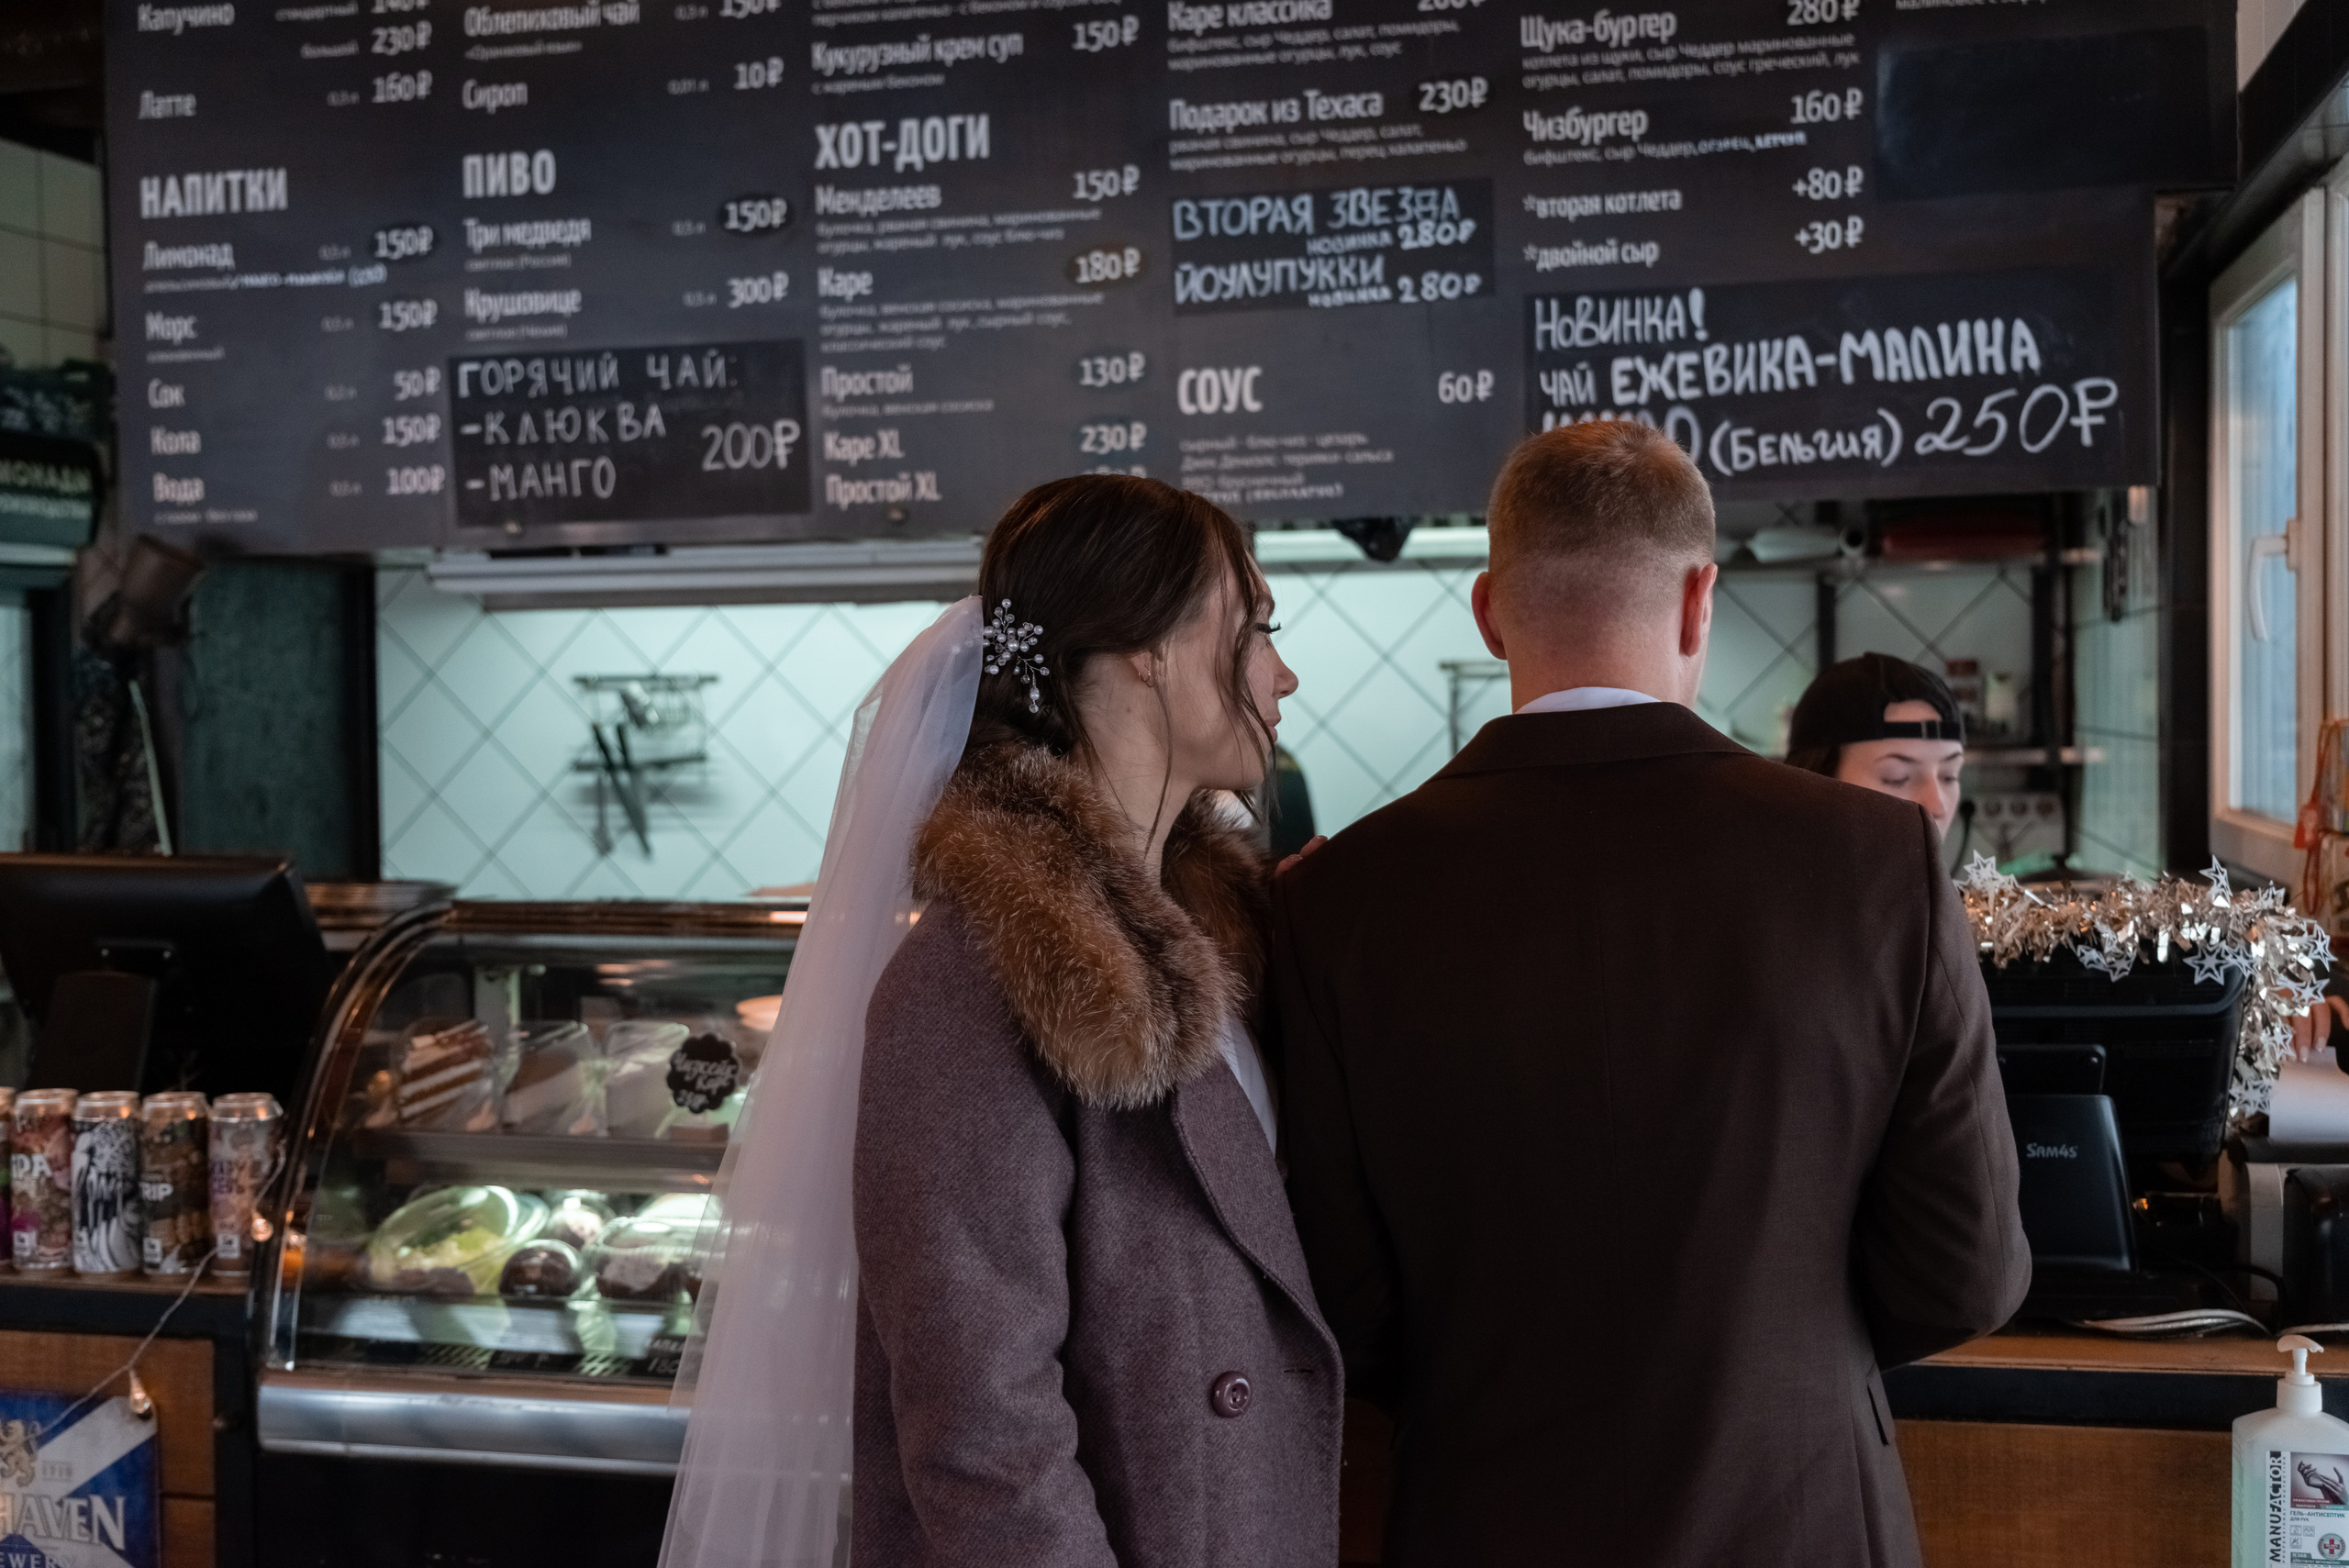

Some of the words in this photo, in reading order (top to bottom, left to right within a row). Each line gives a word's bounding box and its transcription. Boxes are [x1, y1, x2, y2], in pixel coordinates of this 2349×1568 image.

[138, 3, 235, 35] Капучино
[1167, 0, 1225, 37] Каре
[1520, 8, 1677, 53] Щука-бургер
[811, 33, 932, 76] Кукурузный
[986, 33, 1024, 63] суп
[1072, 14, 1141, 53] 150₽
[139, 90, 197, 119] Латте
[462, 79, 528, 114] Сироп
[734, 56, 785, 90] 10₽
[1169, 98, 1268, 134] Подарок
[1272, 98, 1301, 124] из
[1303, 89, 1385, 121] Техаса
[1419, 76, 1489, 114] 230₽
[1522, 106, 1648, 146] Чизбургер
[1789, 86, 1864, 125] 160₽
[814, 113, 990, 173] ХОТ-ДОГИ
[139, 167, 288, 219] НАПИТКИ
[462, 149, 557, 198] ПИВО
[815, 183, 941, 217] Менделеев
[1072, 163, 1141, 202] 150₽
[463, 217, 501, 254] Три
[723, 197, 787, 231] 150₽
[1172, 193, 1314, 240] ВТОРАЯ
[1328, 186, 1460, 228] ЗВЕЗДА
[1604, 188, 1683, 215] котлета
[143, 240, 235, 272] Лимонад
[374, 226, 433, 260] 150₽
[1620, 240, 1660, 268] сыр
[463, 288, 582, 324] Крушовице
[727, 271, 789, 308] 300₽
[817, 267, 873, 303] Каре
[1074, 247, 1141, 284] 180₽
[1174, 254, 1385, 305] ЙОУЛУПУККИ
[145, 310, 198, 345] Морс
[379, 298, 438, 331] 150₽
[458, 350, 619, 398] ГОРЯЧИЙ
[820, 363, 914, 403] Простой
[1078, 351, 1145, 386] 130₽
[1540, 361, 1597, 407] ЧАЙ
[1610, 317, 2041, 406] ЕЖЕВИКА-МАЛИНА
[148, 377, 185, 409] Сок
[394, 366, 440, 401] 50₽
[1177, 365, 1264, 415] СОУС
[1438, 369, 1495, 404] 60₽
[150, 425, 202, 455] Кола
[382, 413, 440, 447] 150₽
[1914, 376, 2118, 455] 250₽
[700, 418, 801, 472] 200₽
[824, 430, 876, 467] Каре
[877, 428, 906, 458] XL
[1079, 422, 1147, 454] 230₽
[153, 472, 205, 506] Вода
[386, 464, 445, 495] 100₽
[826, 471, 913, 511] Простой
[914, 469, 942, 501] XL
[2269, 1451, 2282, 1562] MANUFACTOR
[2290, 1510, 2345, 1518] ГЕЛЬ-АНТИСЕПТИК
